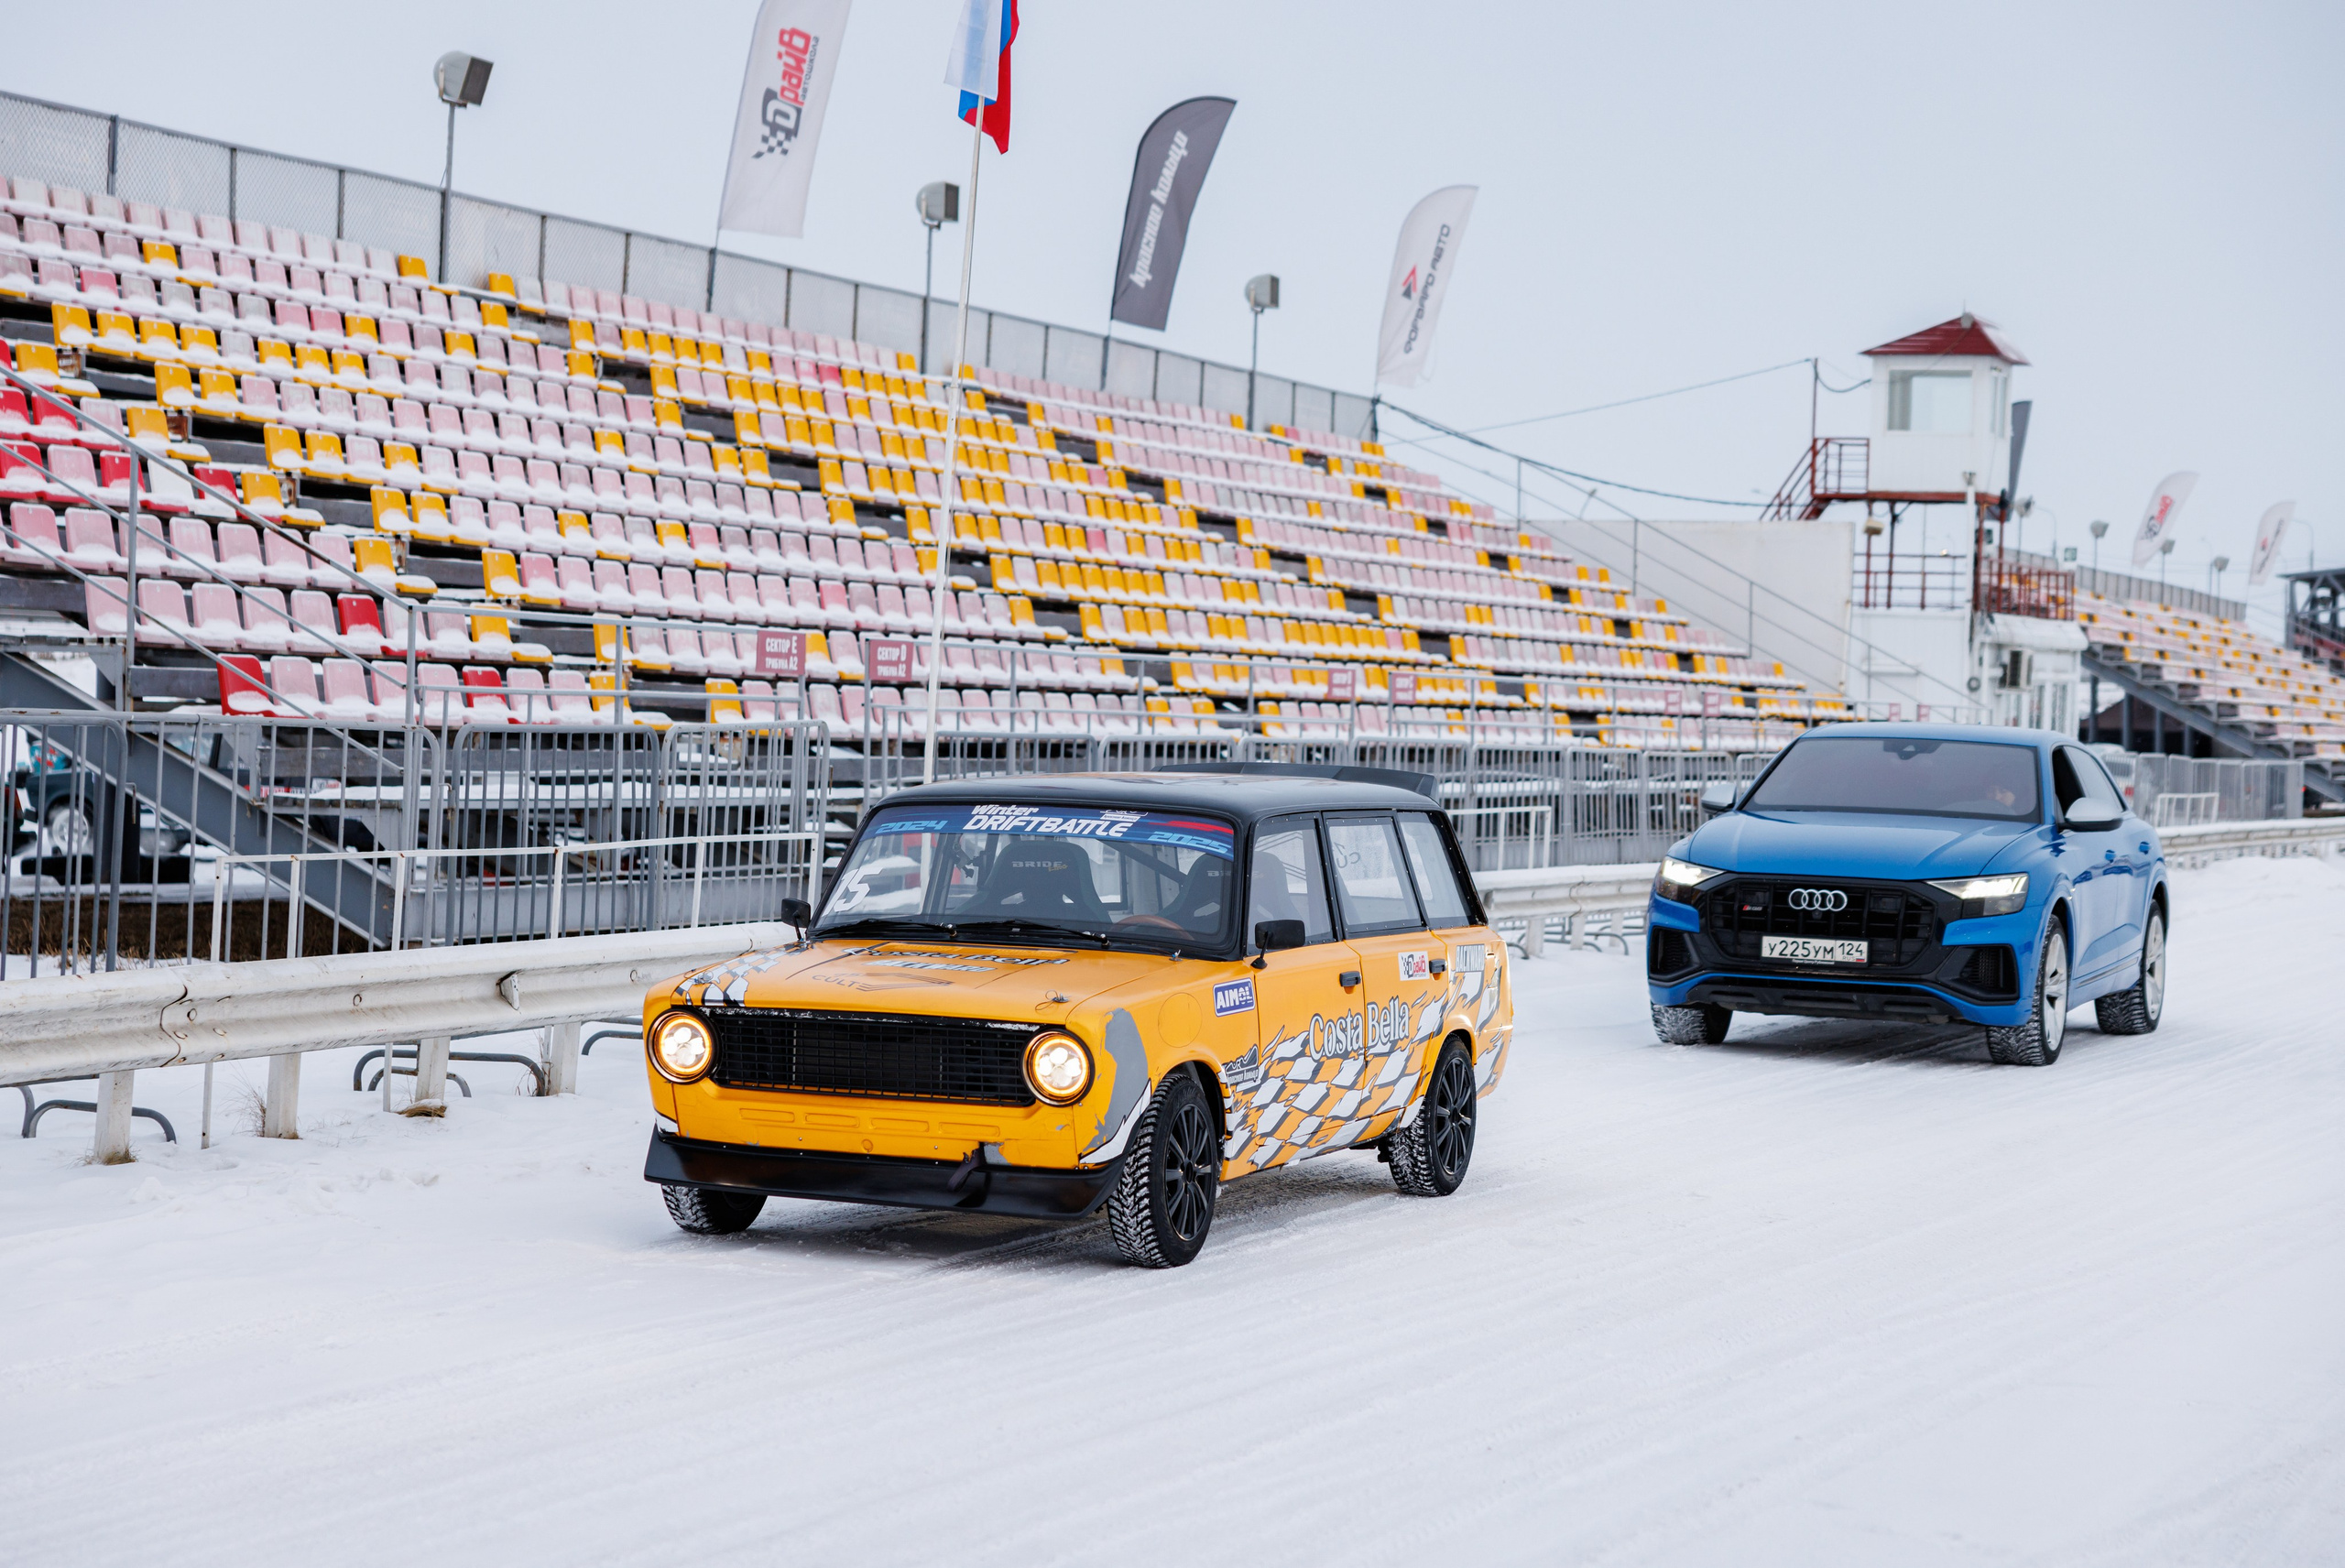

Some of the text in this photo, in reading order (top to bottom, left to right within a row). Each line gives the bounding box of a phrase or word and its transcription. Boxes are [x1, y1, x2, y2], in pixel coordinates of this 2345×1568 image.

[766, 637, 791, 653] СЕКТОР
[878, 646, 900, 661] СЕКТОР
[971, 804, 1039, 815] Winter
[876, 821, 948, 833] 2024
[963, 815, 1133, 837] DRIFTBATTLE
[1148, 831, 1231, 854] 2025
[1838, 942, 1863, 956] 124
[812, 975, 861, 988] CULT
[1216, 986, 1252, 1009] AIMOL
[1309, 995, 1411, 1061] Costa Bella
